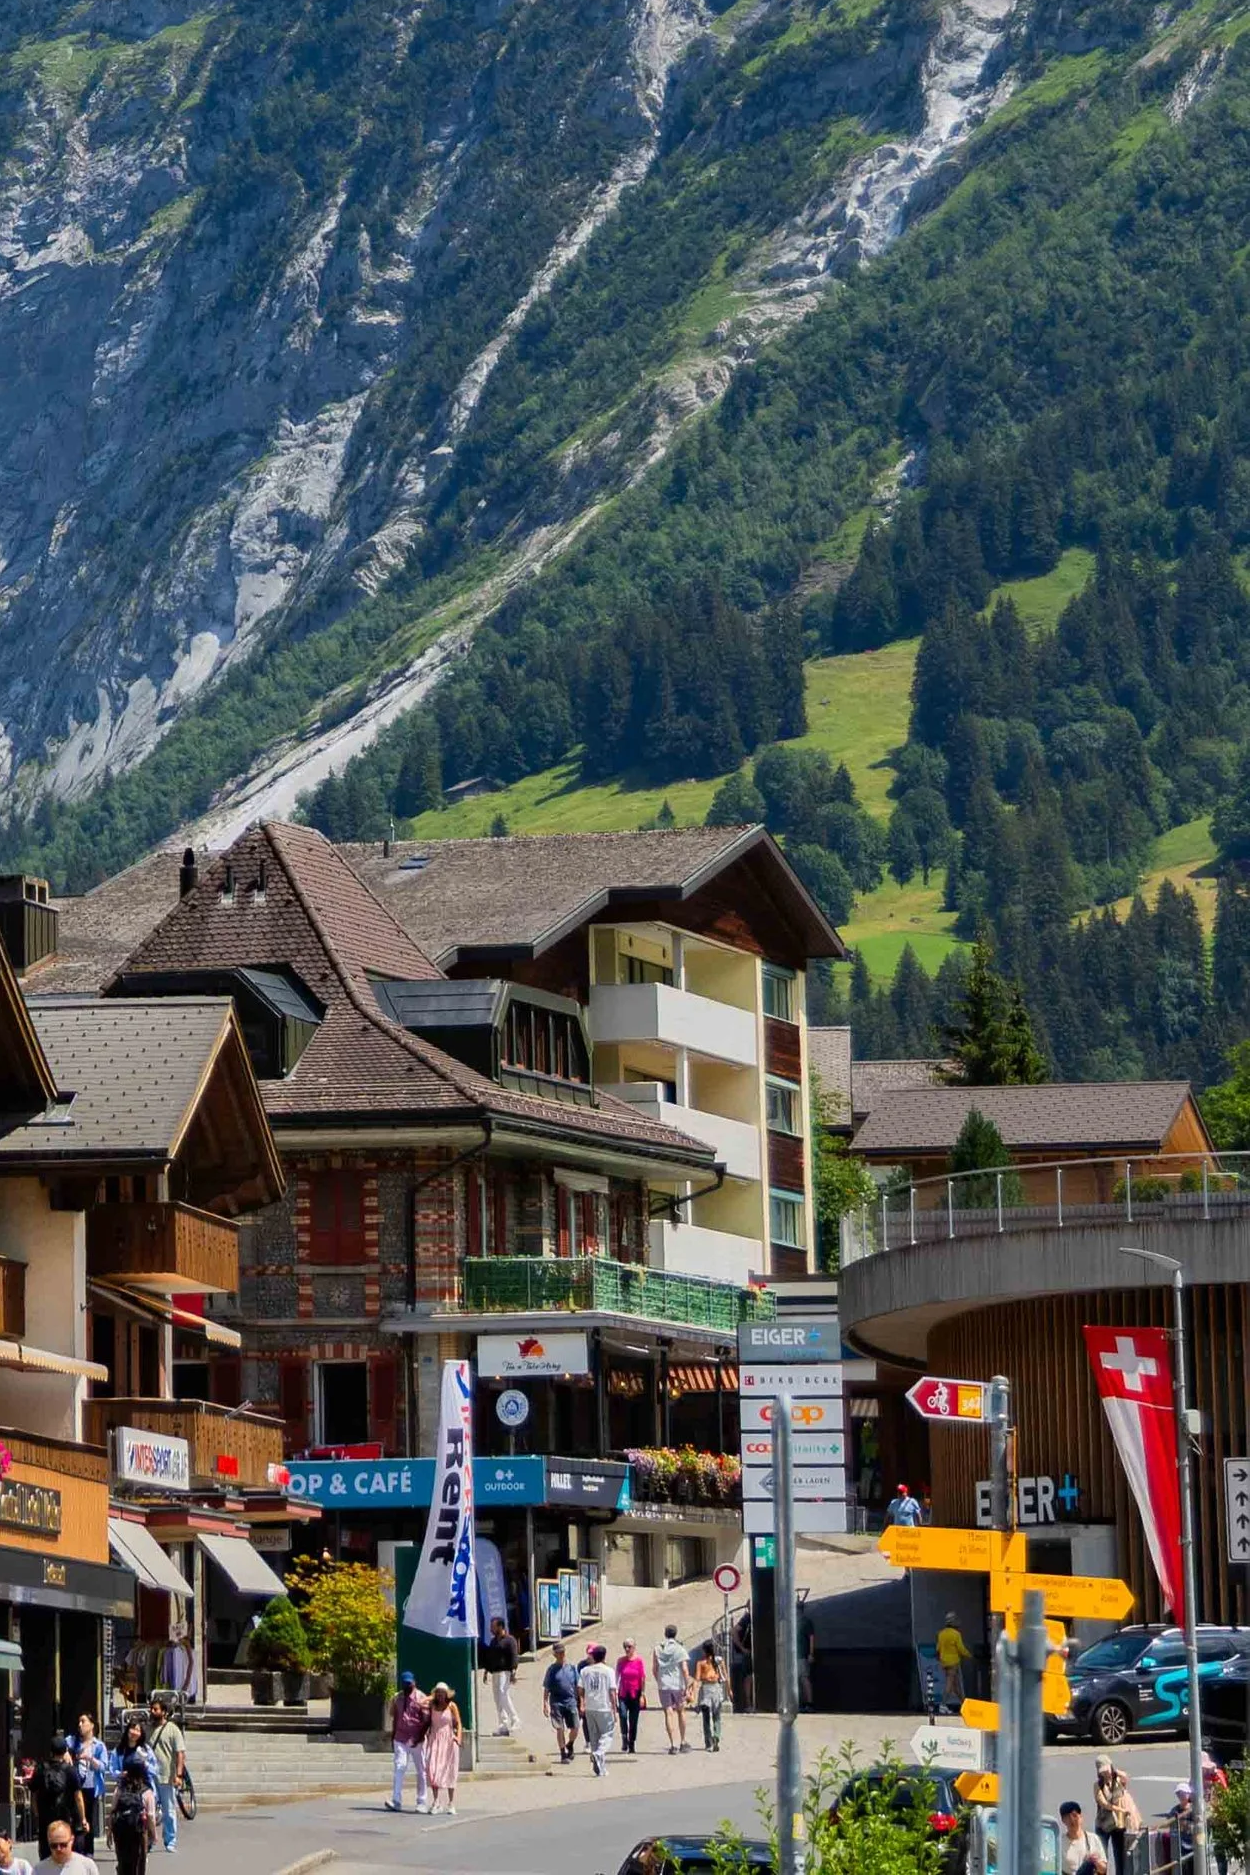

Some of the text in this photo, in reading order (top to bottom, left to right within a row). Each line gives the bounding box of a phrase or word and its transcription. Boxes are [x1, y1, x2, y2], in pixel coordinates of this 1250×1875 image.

[759, 1405, 825, 1425] cop
[792, 1443, 827, 1455] itality
[283, 1465, 412, 1496] OP & CAFÉ
[485, 1482, 525, 1491] OUTDOOR
[429, 1427, 463, 1567] Rent
